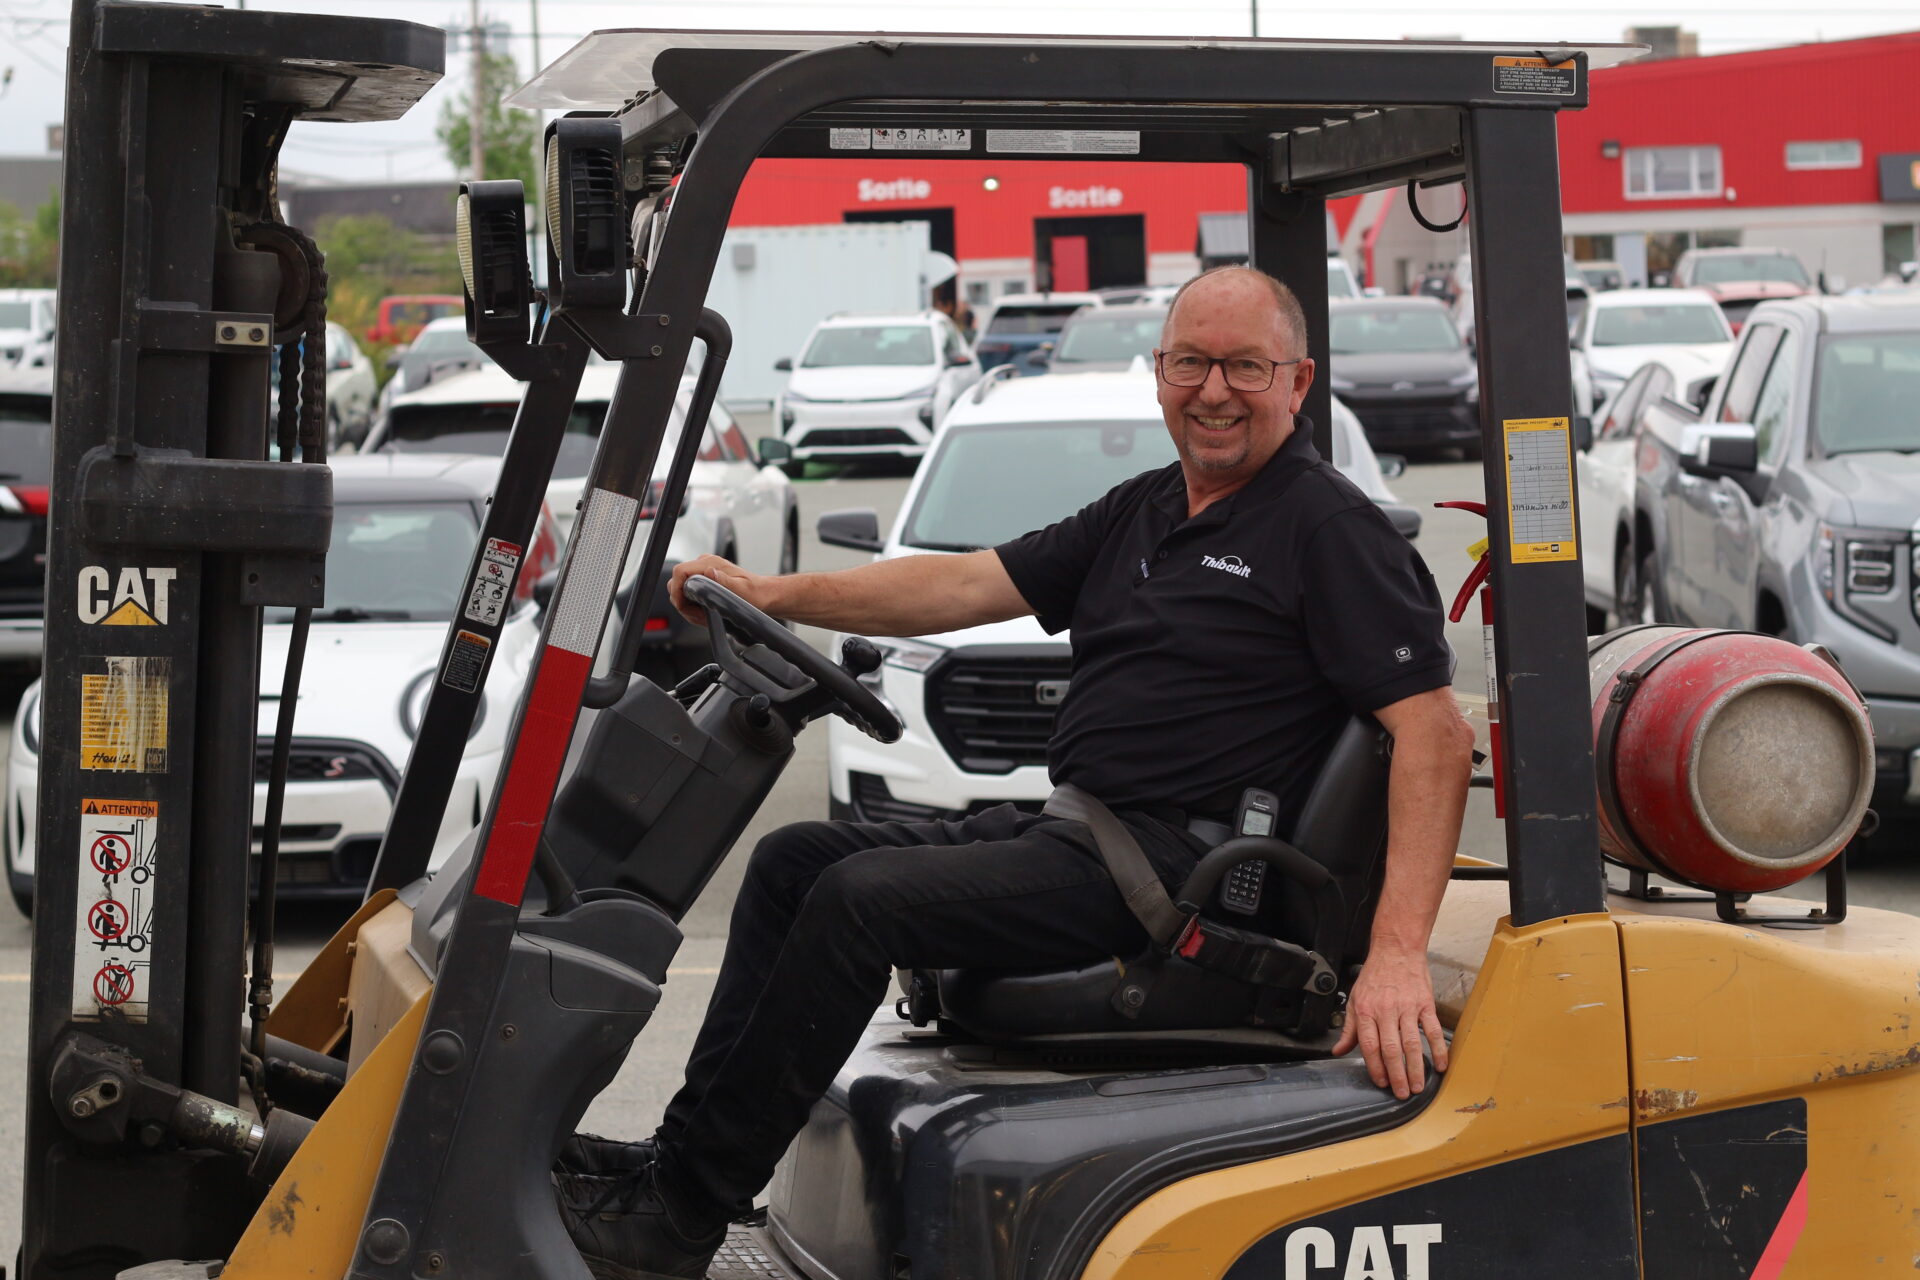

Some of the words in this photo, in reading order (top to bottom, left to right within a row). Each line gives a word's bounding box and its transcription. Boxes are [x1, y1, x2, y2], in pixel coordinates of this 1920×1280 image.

[858, 179, 931, 201] Sortie
[1050, 186, 1123, 208] Sortie
[501, 546, 517, 555] DANGER
[1201, 555, 1251, 578] Thibault
[78, 566, 176, 625] CAT
[101, 803, 155, 816] ATTENTION
[1285, 1223, 1442, 1280] CAT
